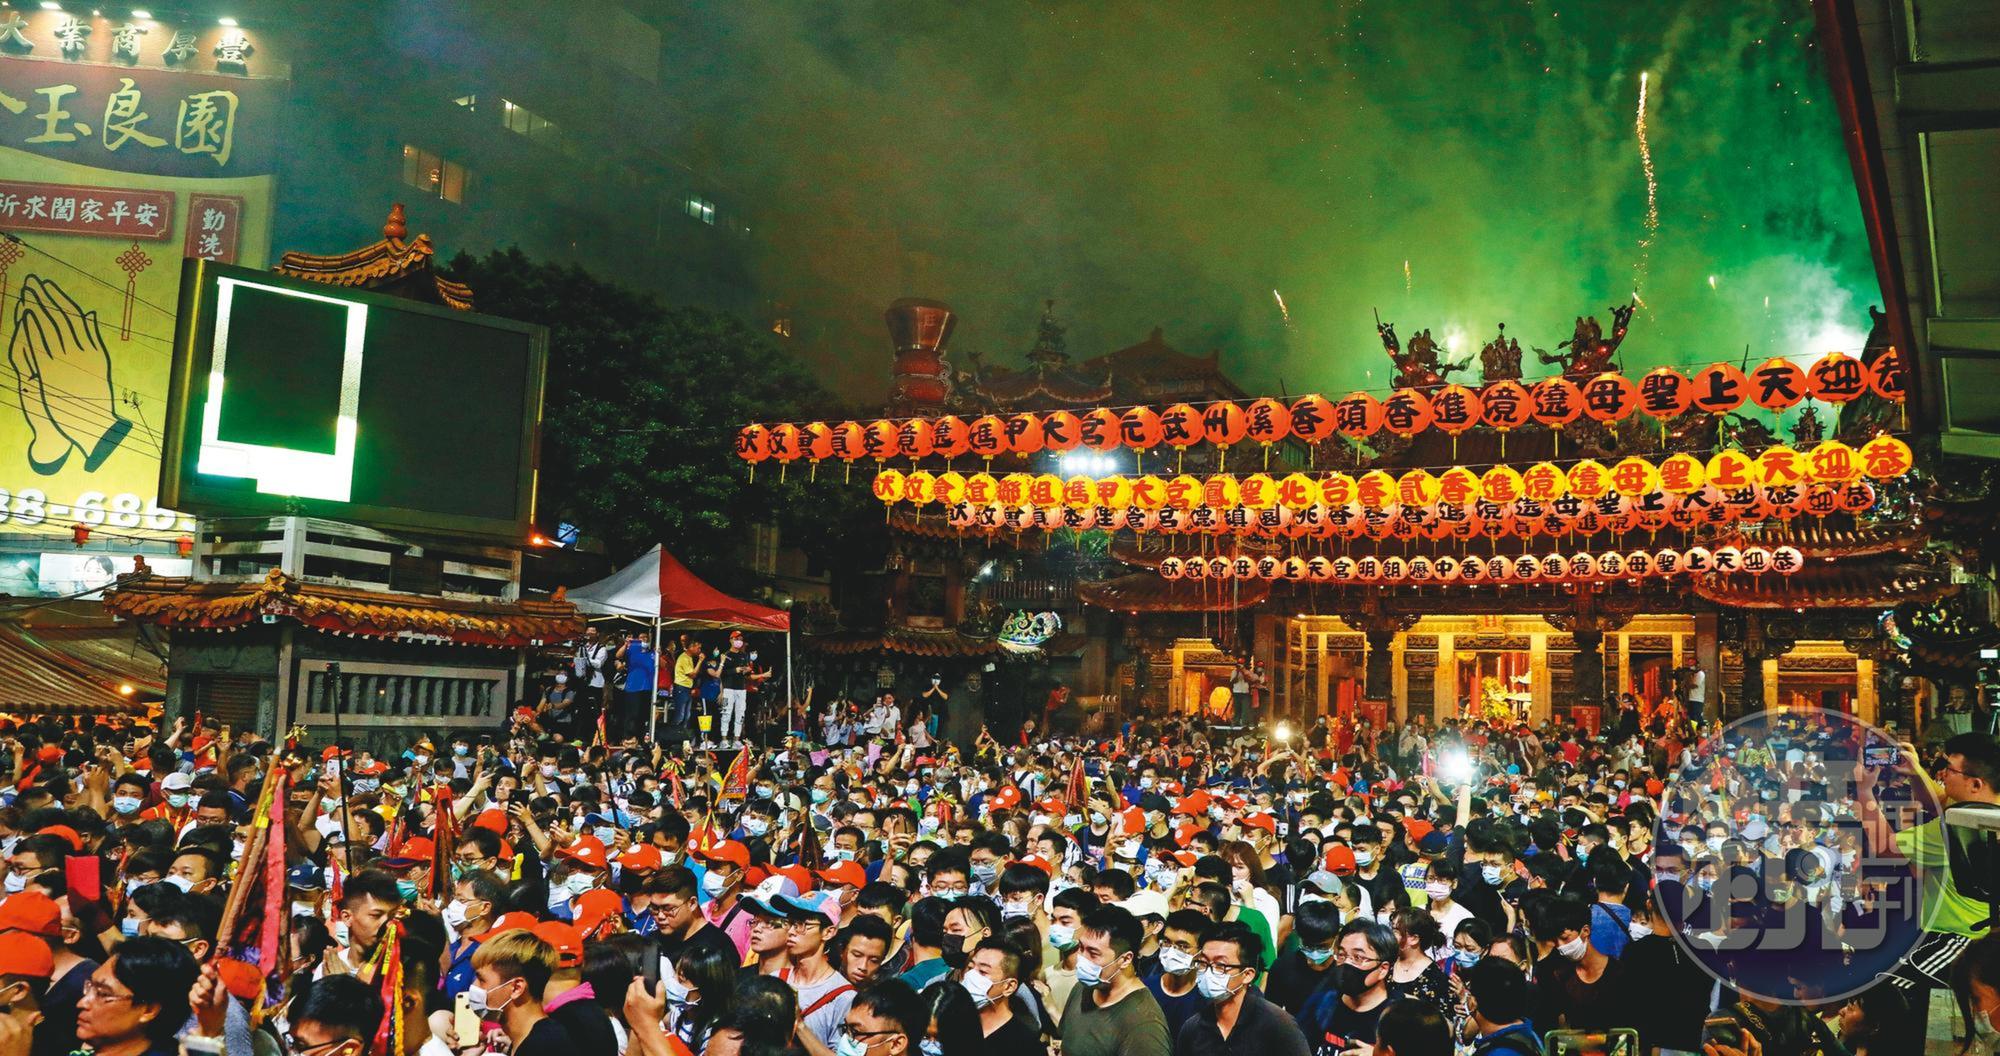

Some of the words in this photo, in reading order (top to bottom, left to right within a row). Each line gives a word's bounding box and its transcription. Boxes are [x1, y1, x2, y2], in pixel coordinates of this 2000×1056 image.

[0, 78, 239, 167] 玉良園
[198, 208, 226, 262] 勤洗
[0, 488, 196, 532] 8-686
